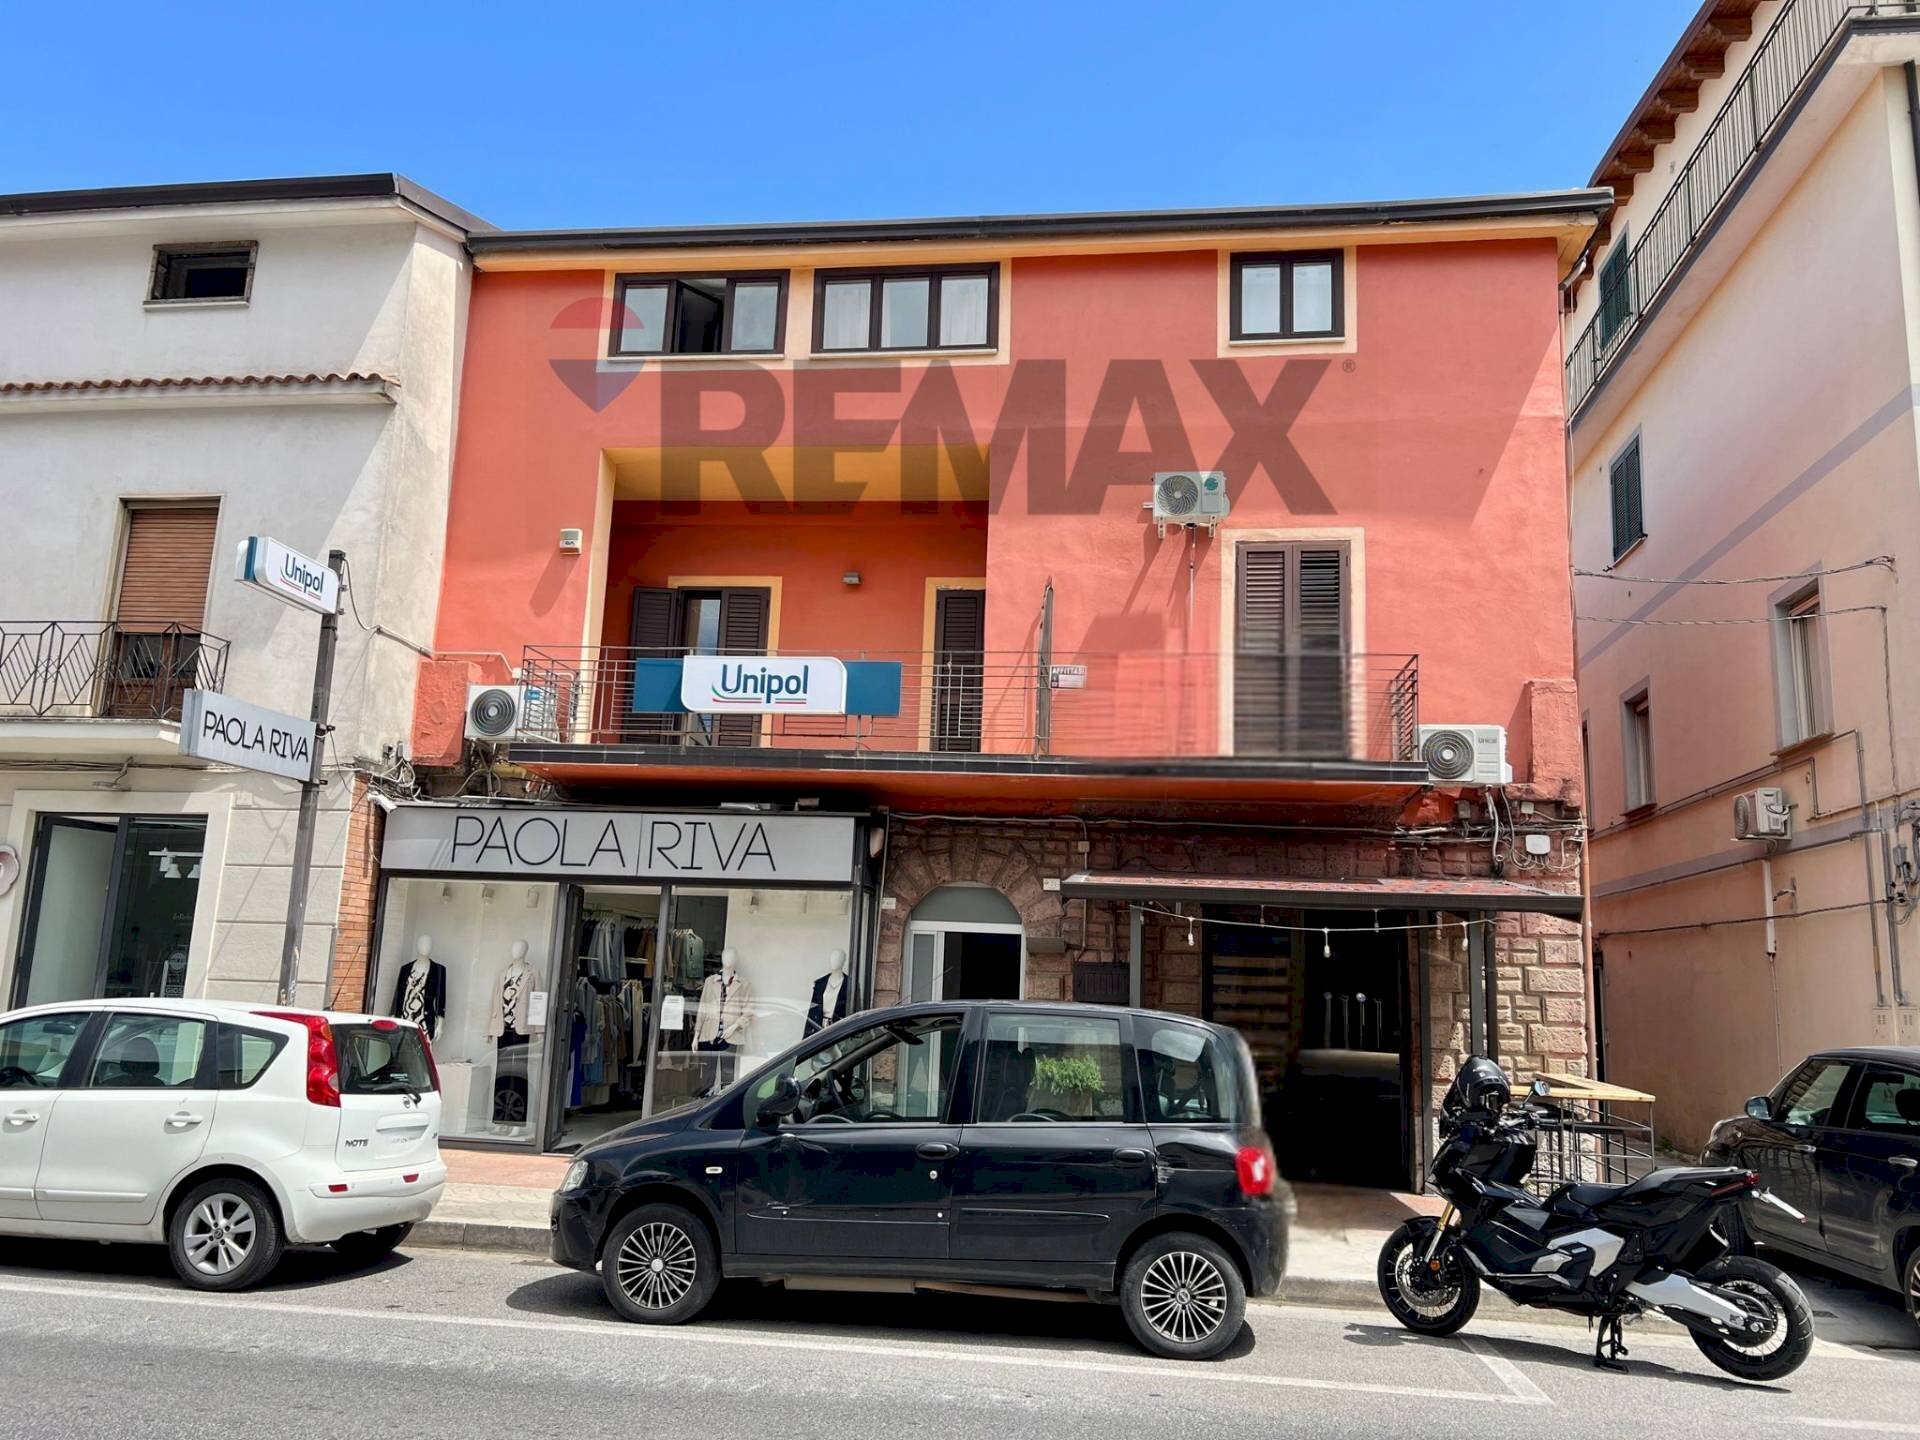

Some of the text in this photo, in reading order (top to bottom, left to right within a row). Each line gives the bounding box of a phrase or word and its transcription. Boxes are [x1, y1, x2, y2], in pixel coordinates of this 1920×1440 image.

[284, 553, 324, 594] Unipol
[721, 664, 809, 704] Unipol
[202, 709, 309, 763] PAOLA RIVA
[451, 815, 777, 872] PAOLA RIVA
[345, 1139, 369, 1148] NOTE
